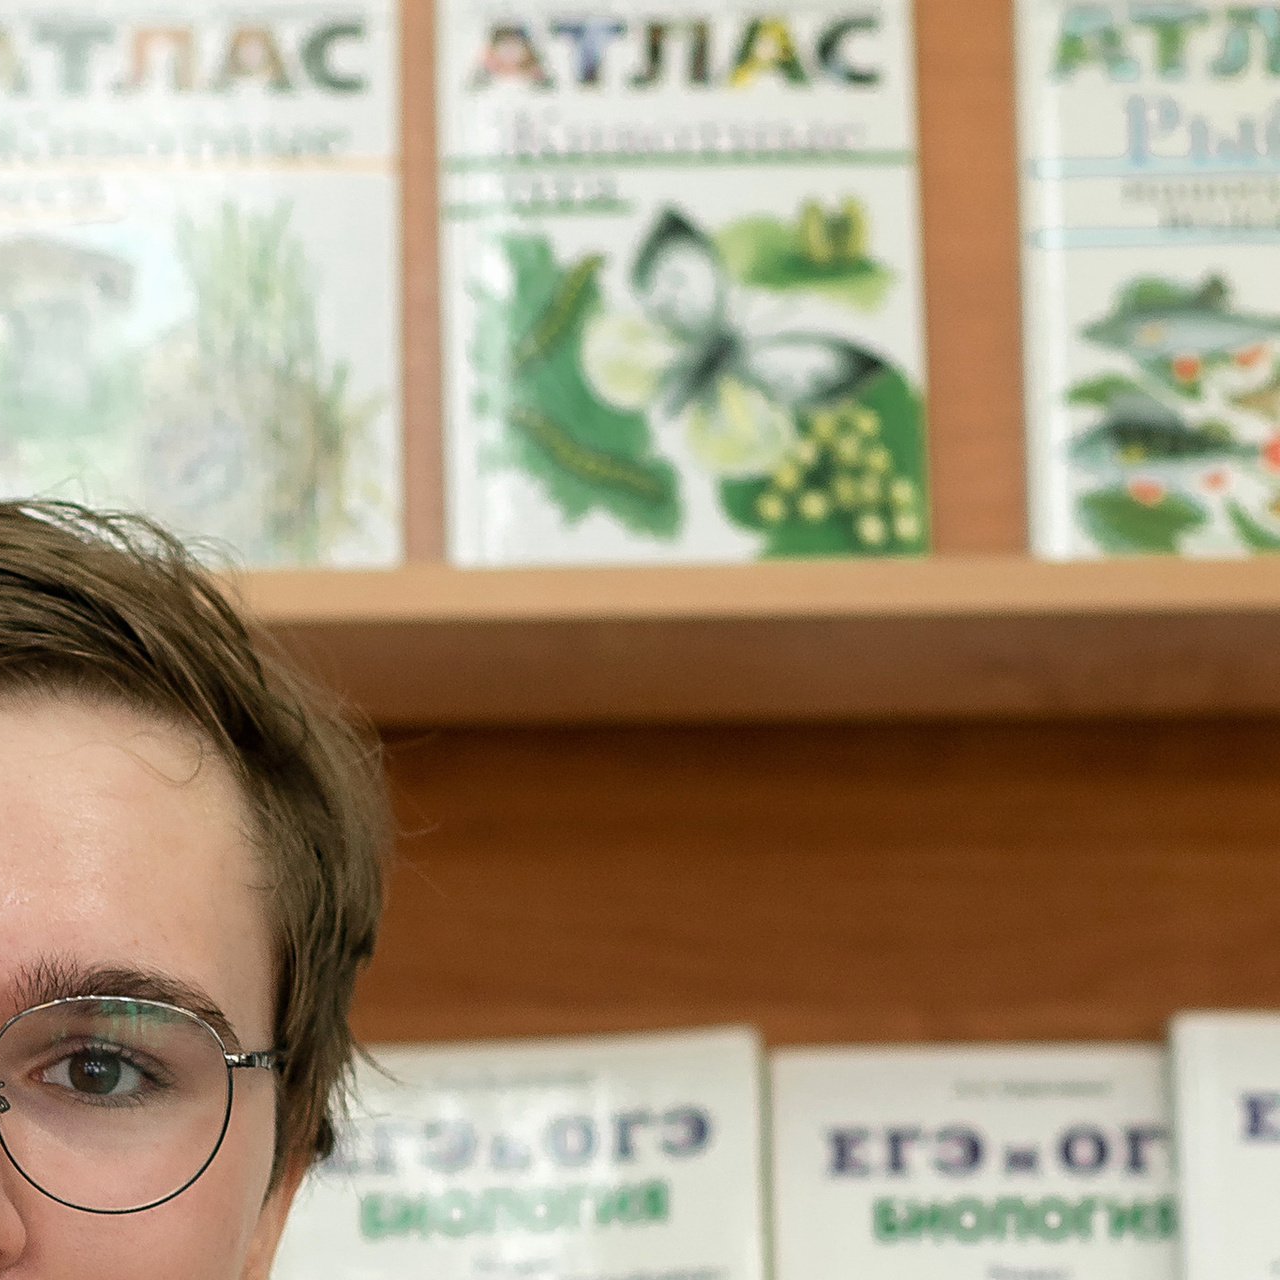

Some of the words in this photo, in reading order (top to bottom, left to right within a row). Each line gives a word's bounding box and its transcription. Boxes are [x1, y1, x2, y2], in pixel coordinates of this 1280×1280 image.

[468, 14, 880, 88] АТЛАС
[548, 1108, 712, 1166] ОГЭ
[826, 1126, 984, 1176] ЕГЭ
[360, 1180, 670, 1240] БИОЛОГИЯ
